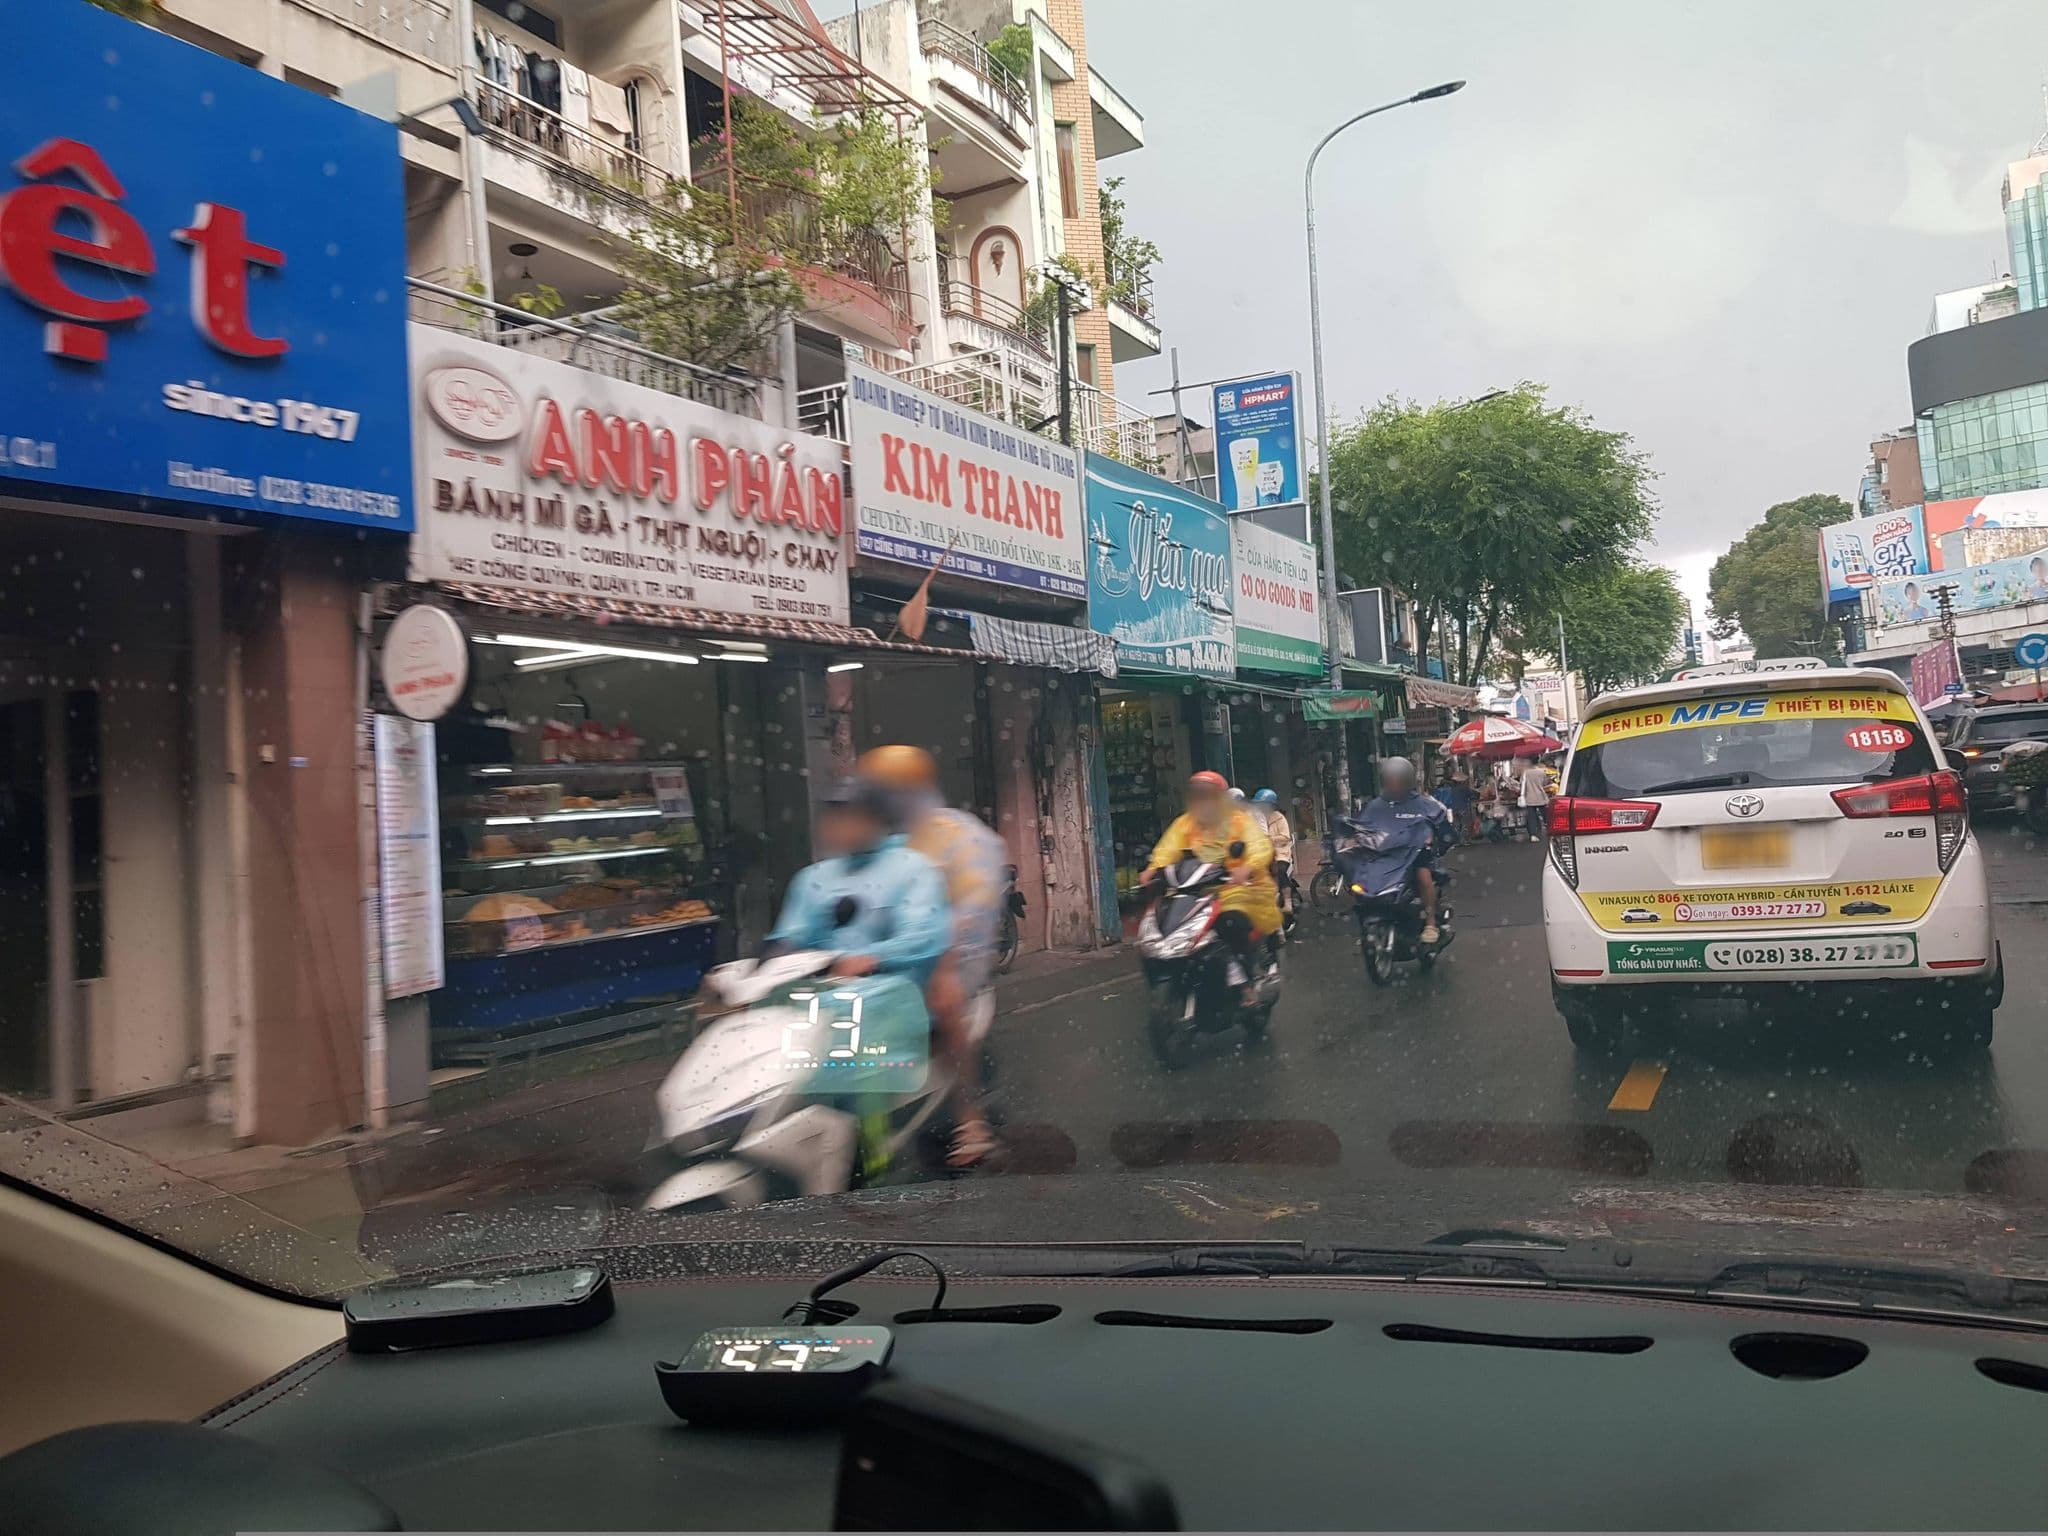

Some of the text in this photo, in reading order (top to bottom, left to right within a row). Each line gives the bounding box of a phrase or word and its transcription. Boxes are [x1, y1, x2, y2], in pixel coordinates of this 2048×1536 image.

[163, 380, 360, 443] since 1967
[1244, 390, 1286, 407] HPMART
[528, 398, 679, 504] ANH
[168, 460, 257, 497] Hotline
[880, 432, 1064, 540] KIM THANH
[432, 476, 526, 524] BÁNH
[574, 500, 615, 538] GÀ
[635, 515, 690, 554] THỊT
[695, 526, 767, 569] NGUỘI
[784, 542, 839, 576] CHAY
[861, 506, 912, 535] CHUYÊN
[920, 520, 946, 544] MUA
[947, 524, 971, 548] BÁN
[972, 534, 999, 556] TRAO
[1019, 543, 1046, 567] VÀNG
[1876, 517, 1909, 535] 100%
[490, 533, 807, 594] CHICKEN COMBINATION VEGETARIAN BREAD
[1128, 500, 1187, 601] Yến
[1873, 535, 1912, 565] GIÁ
[1263, 552, 1283, 574] HÀNG
[1283, 559, 1297, 581] TIỆN
[1268, 581, 1296, 609] GOODS
[1298, 588, 1314, 614] NHI
[1602, 695, 1889, 735] ĐÈN LED MPE THIẾT BỊ ĐIỆN
[1487, 731, 1516, 739] VEDAN
[1849, 729, 1906, 748] 18158
[1584, 845, 1629, 854] INNOVA
[1598, 895, 1641, 906] VINASUN
[1642, 893, 1656, 905] CÓ
[1657, 893, 1681, 904] 806
[1682, 894, 1695, 903] XE
[1697, 892, 1736, 903] TOYOTA
[1737, 890, 1775, 901] HYBRID
[1843, 884, 1881, 897] 1.612
[1882, 883, 1899, 894] LÁI
[1902, 883, 1915, 893] XE
[1692, 910, 1707, 920] Gọi
[1731, 904, 1783, 917] 0393.27
[1782, 903, 1802, 914] 27
[1805, 902, 1822, 913] 27
[1616, 956, 1702, 969] TỔNG ĐÀI DUY NHẤT:
[1736, 947, 1785, 965] (028)
[1825, 946, 1848, 962] 27
[781, 986, 863, 1059] 23
